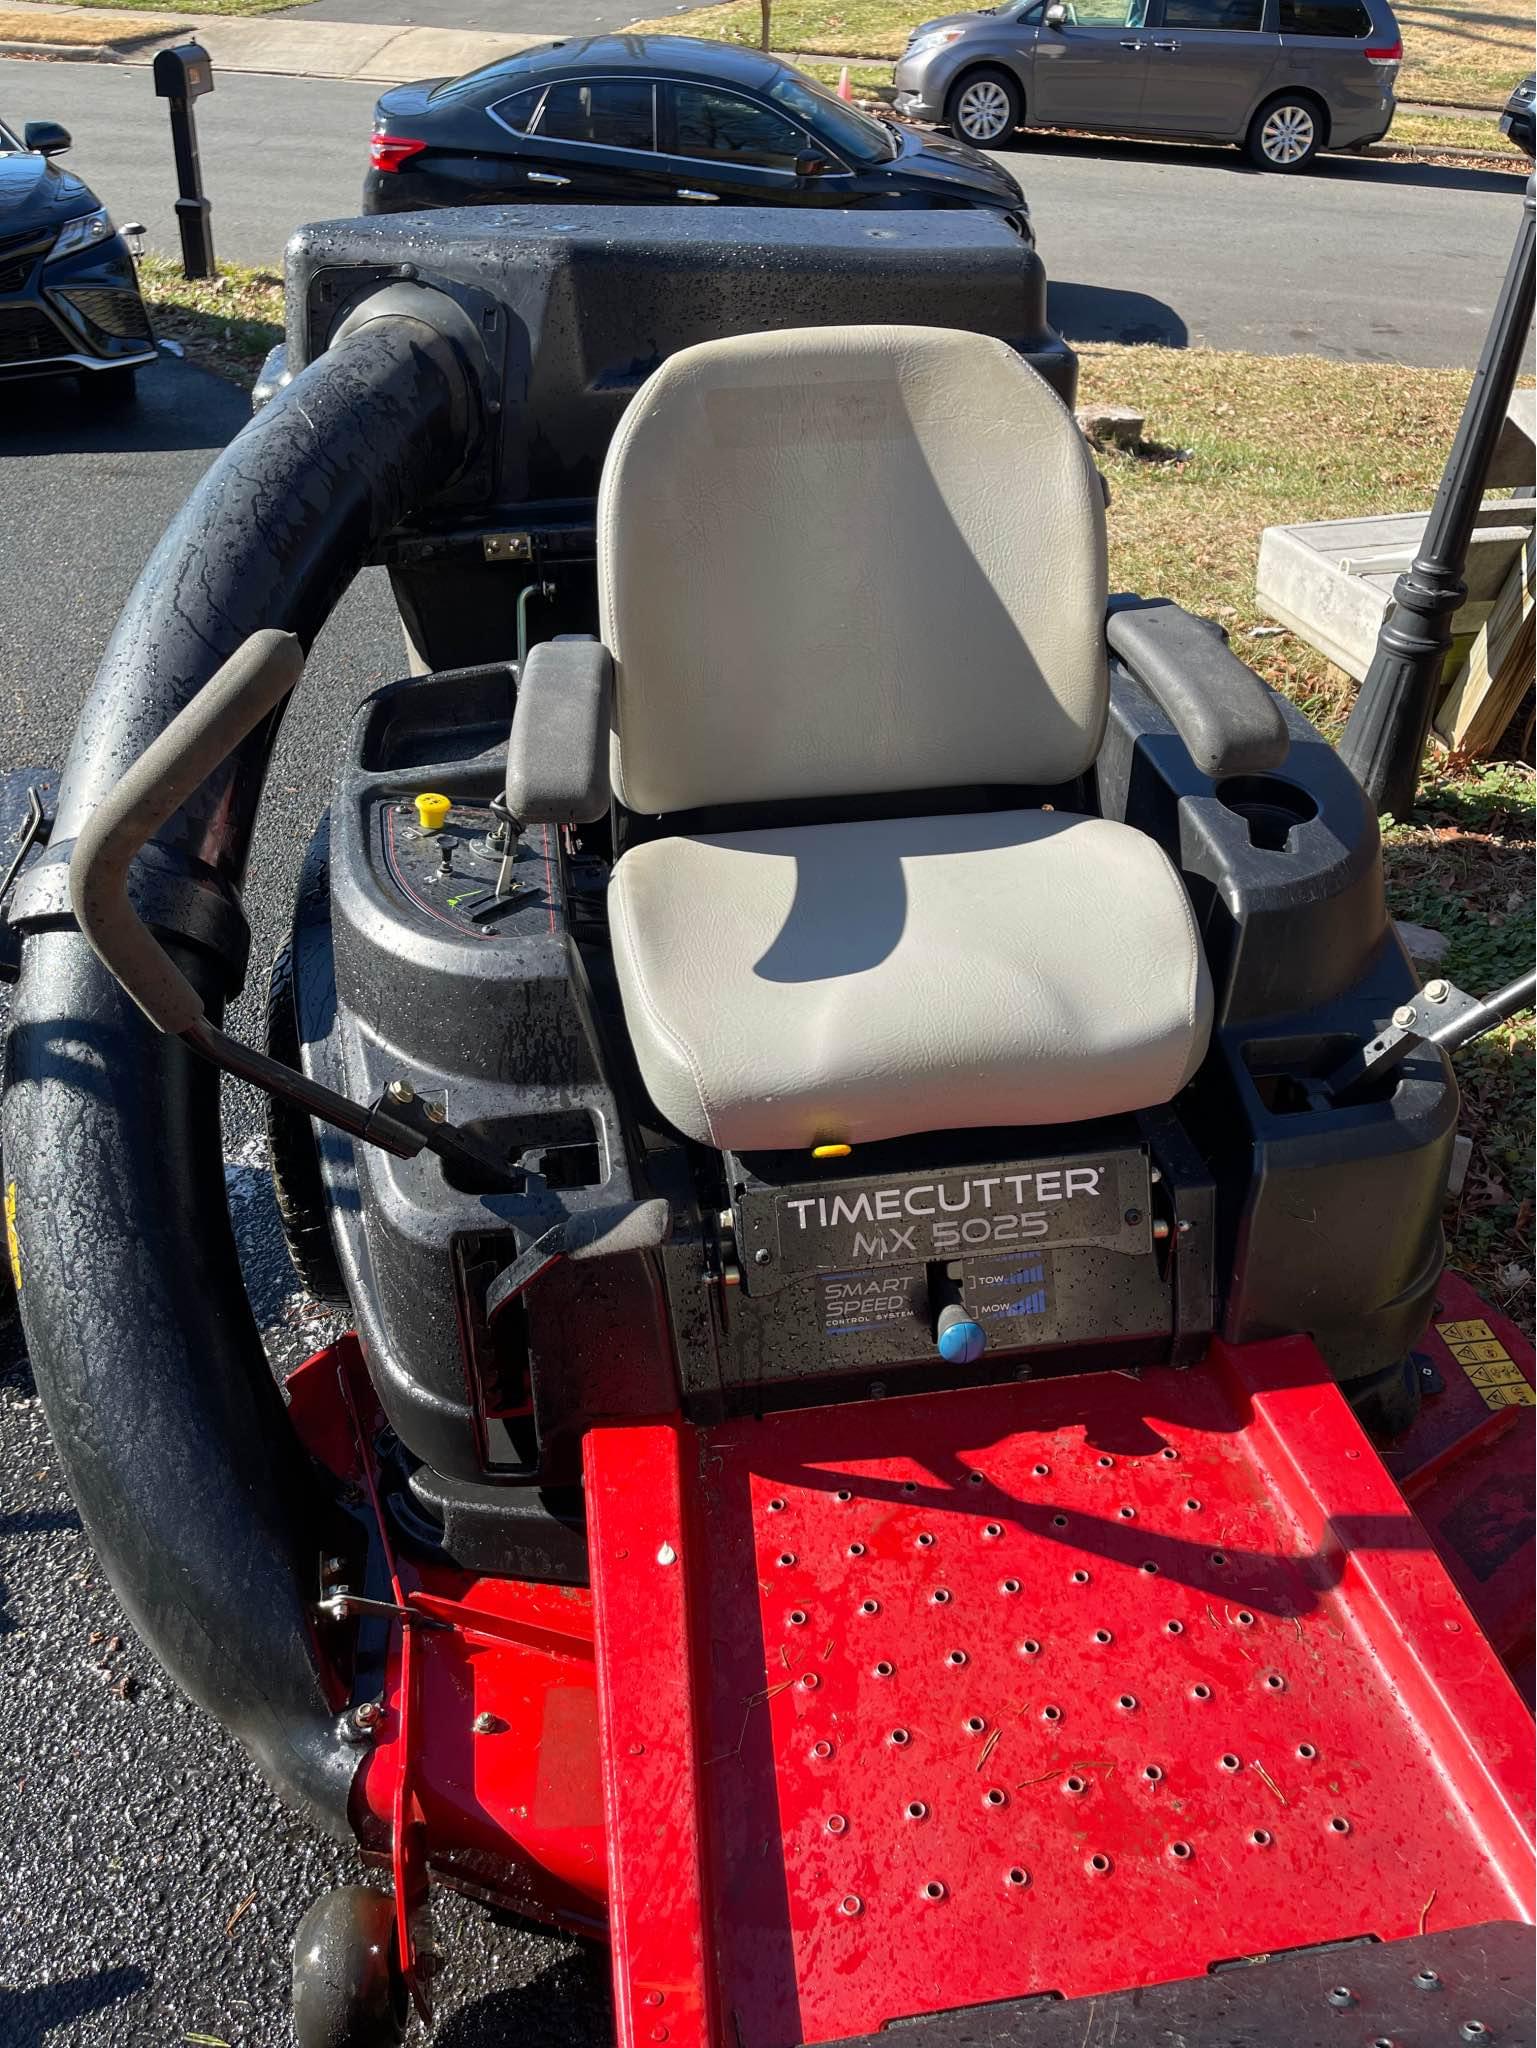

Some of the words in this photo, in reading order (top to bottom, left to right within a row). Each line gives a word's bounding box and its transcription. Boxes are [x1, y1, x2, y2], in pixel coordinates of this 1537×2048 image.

[853, 1226, 916, 1259] MX
[933, 1211, 1049, 1248] 5025
[825, 1276, 914, 1300] SMART
[979, 1275, 1004, 1286] TOW
[826, 1295, 904, 1318] SPEED
[981, 1303, 1010, 1314] MOW
[825, 1316, 870, 1327] CONTROL
[877, 1310, 914, 1321] SYSTEM
